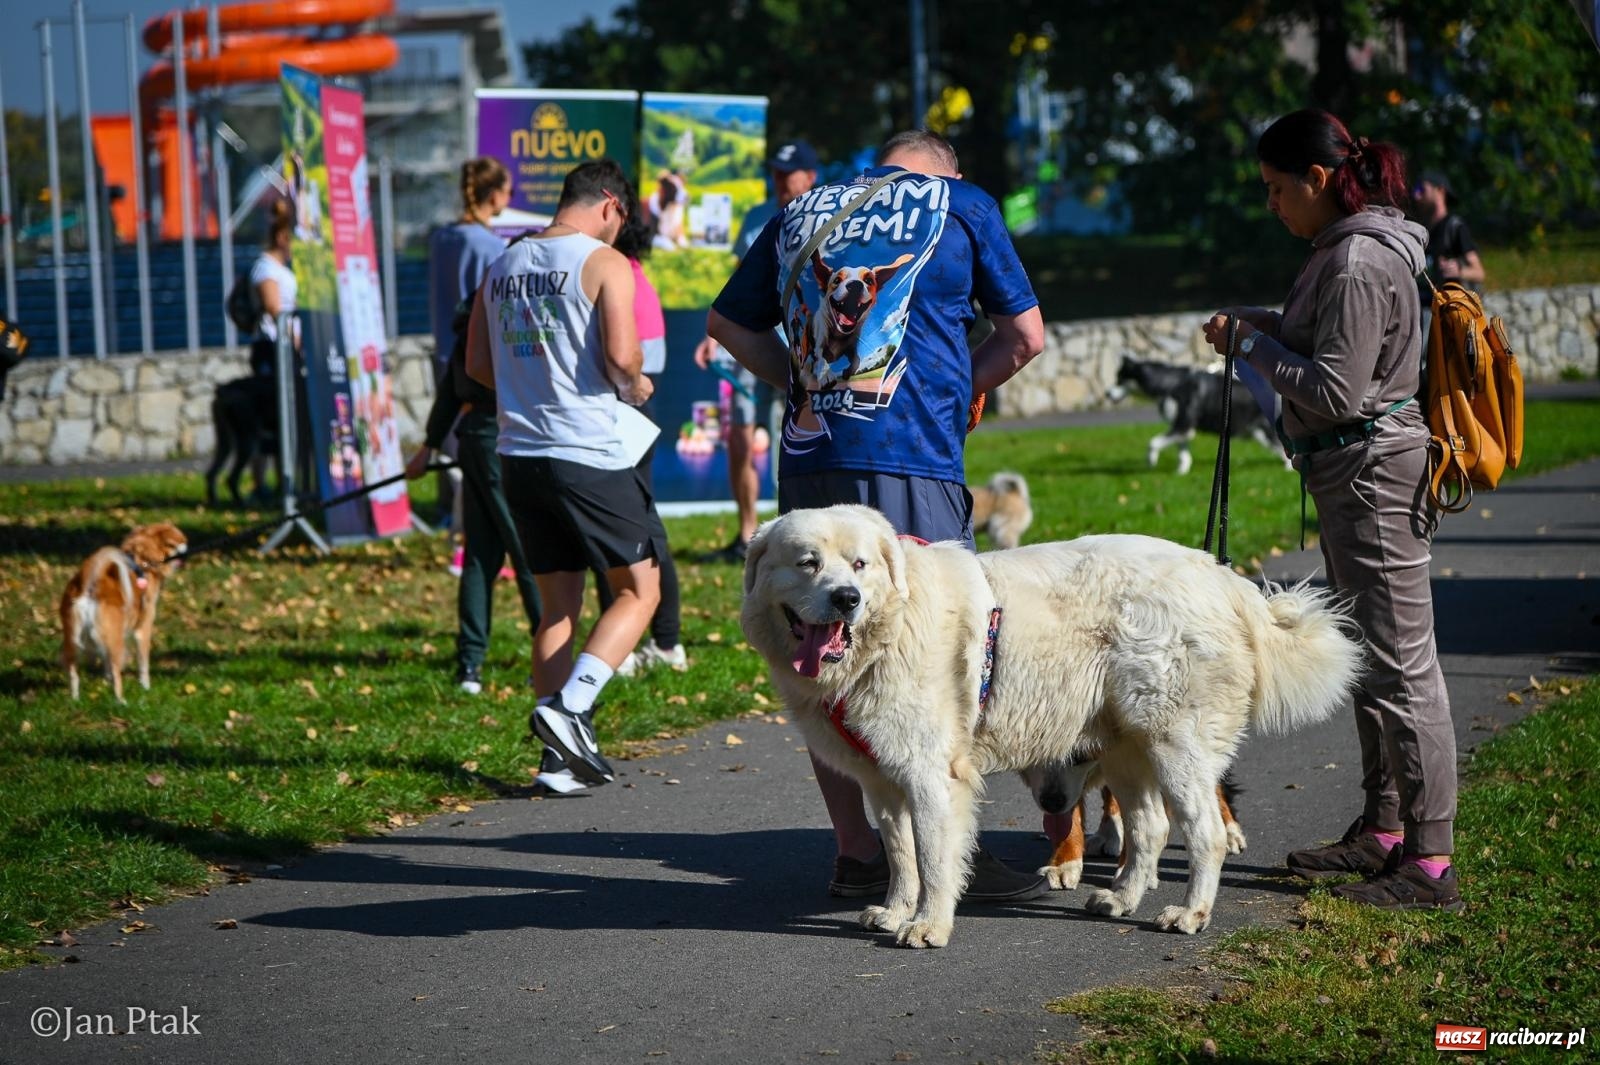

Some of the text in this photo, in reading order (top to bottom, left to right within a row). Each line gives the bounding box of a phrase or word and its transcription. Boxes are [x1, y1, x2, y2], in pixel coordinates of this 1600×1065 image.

[510, 128, 606, 158] nuevo
[490, 270, 569, 303] MATEUSZ
[812, 389, 854, 411] 2024
